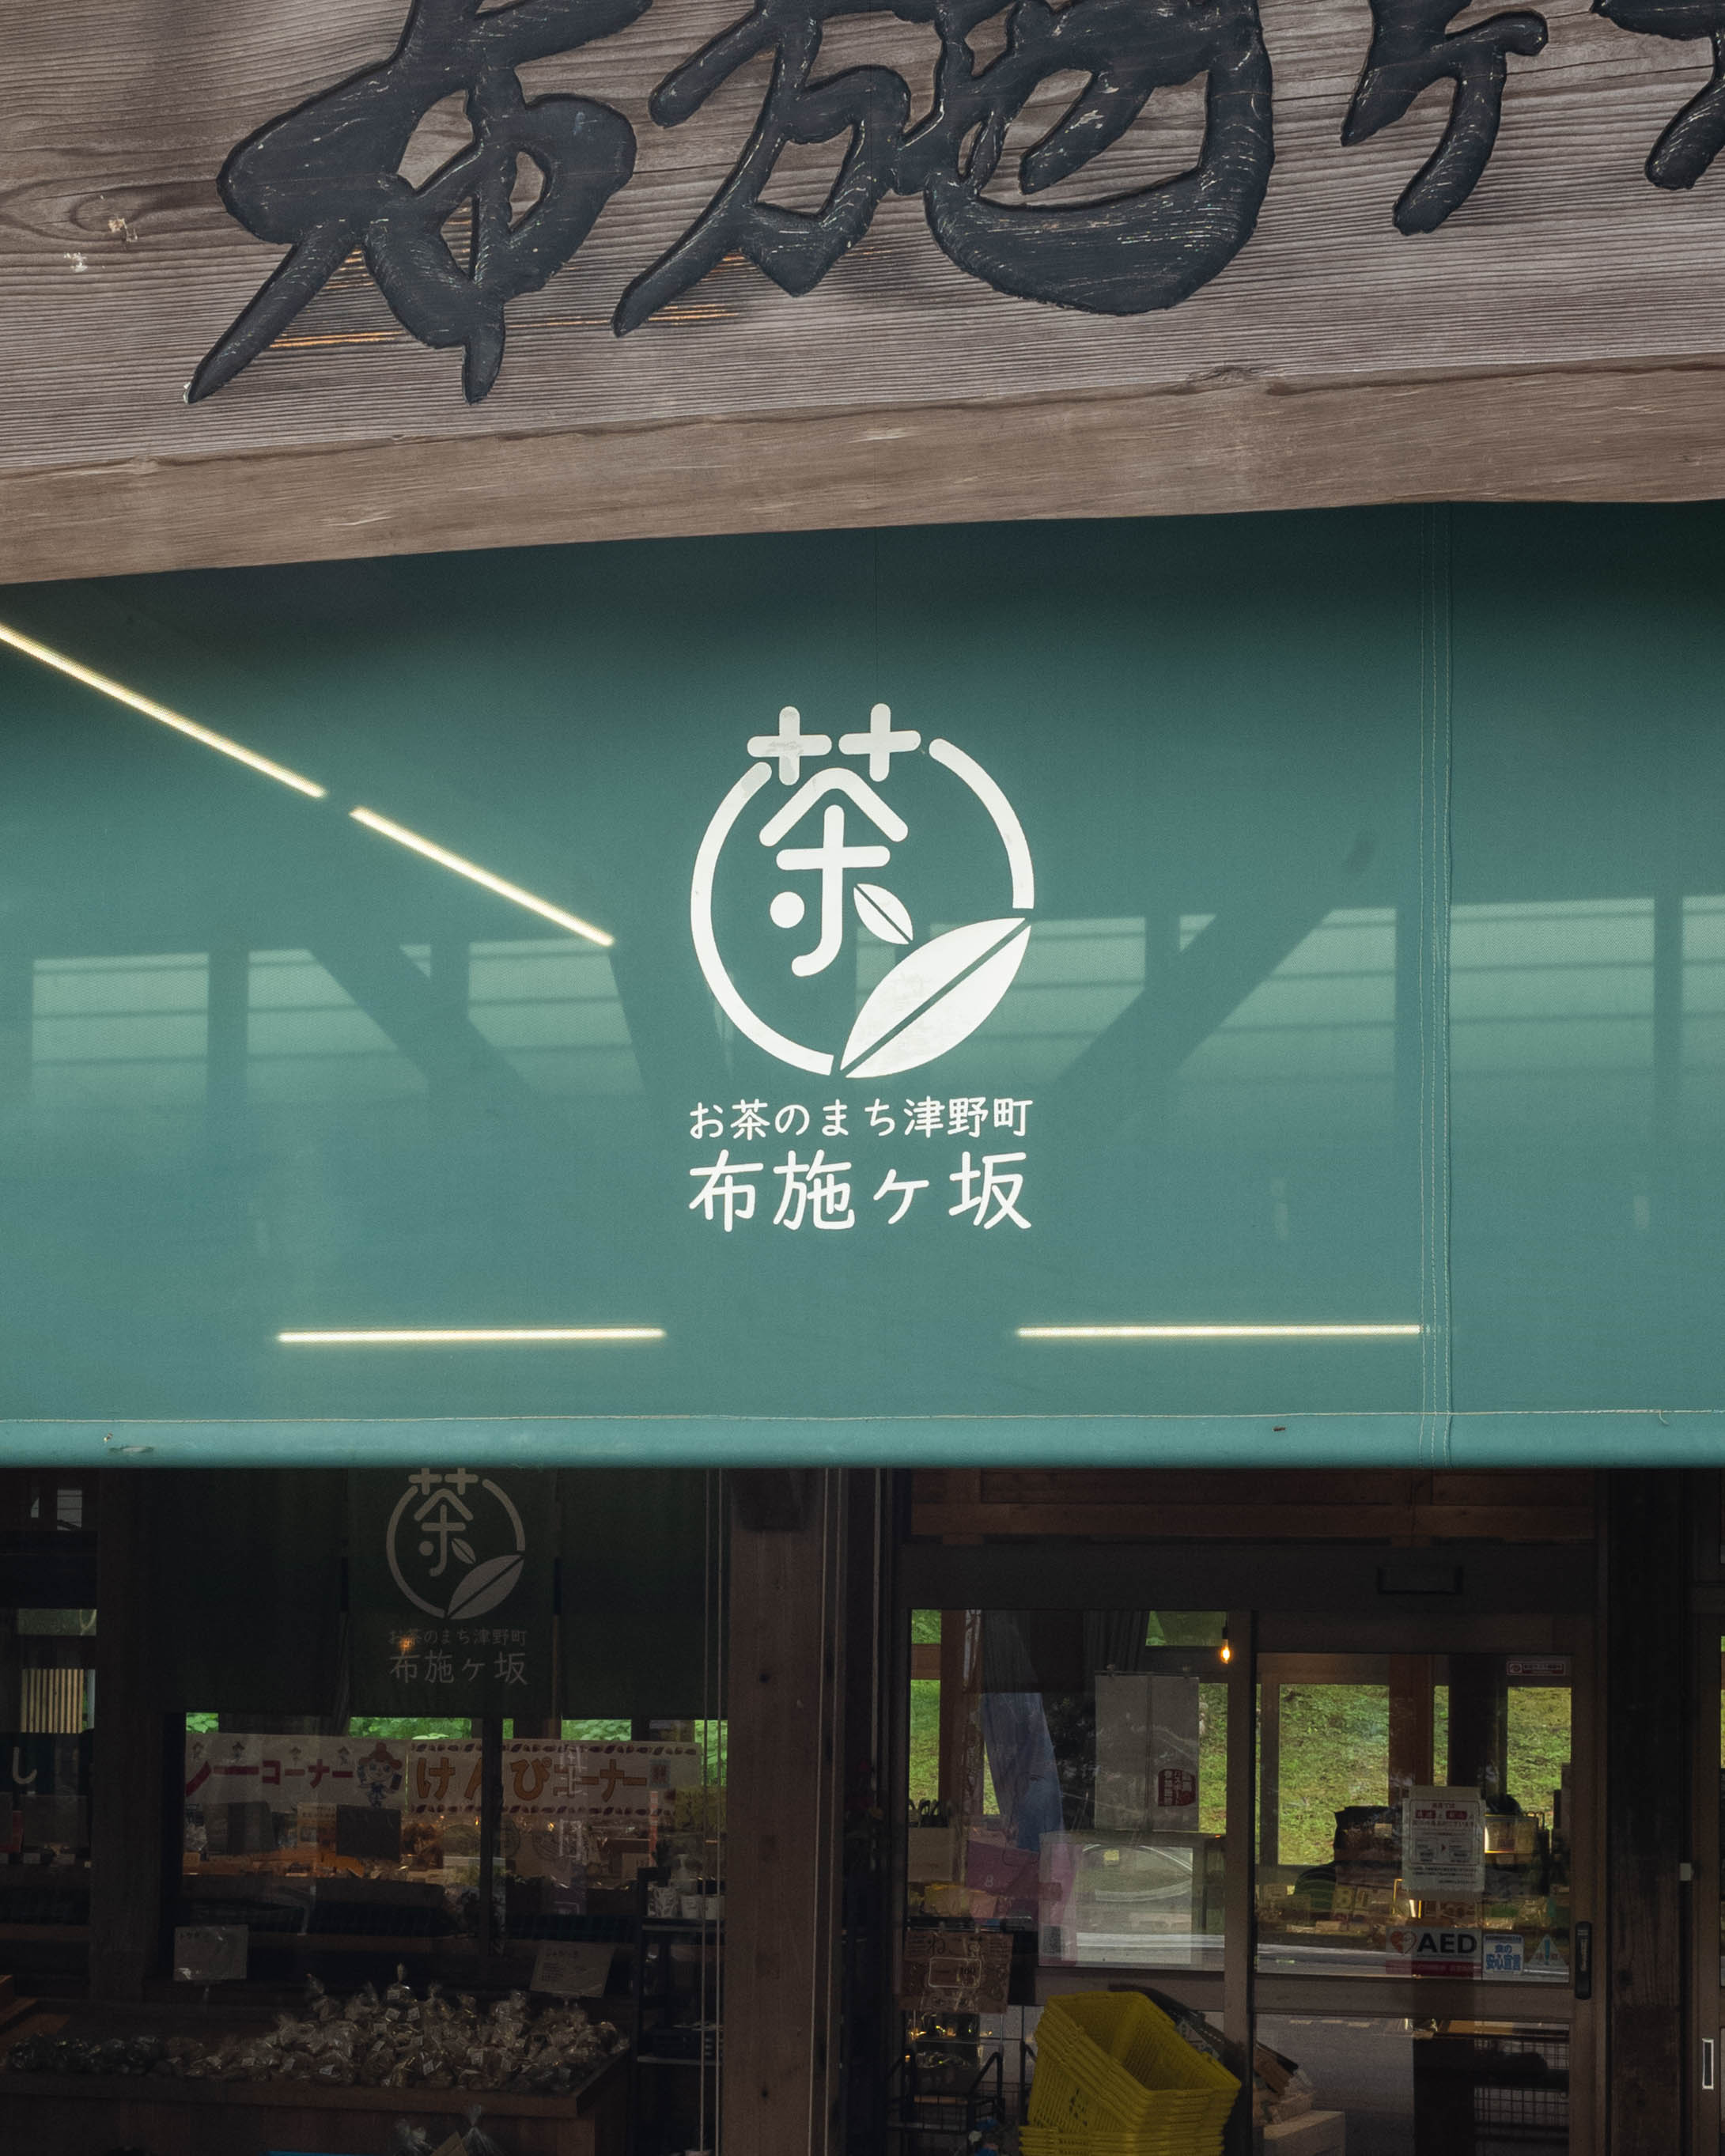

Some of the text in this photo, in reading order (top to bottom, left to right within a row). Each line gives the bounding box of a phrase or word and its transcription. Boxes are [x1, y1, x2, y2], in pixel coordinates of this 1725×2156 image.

[690, 1095, 1034, 1140] お茶のまち津野町
[1416, 1932, 1477, 1954] AED
